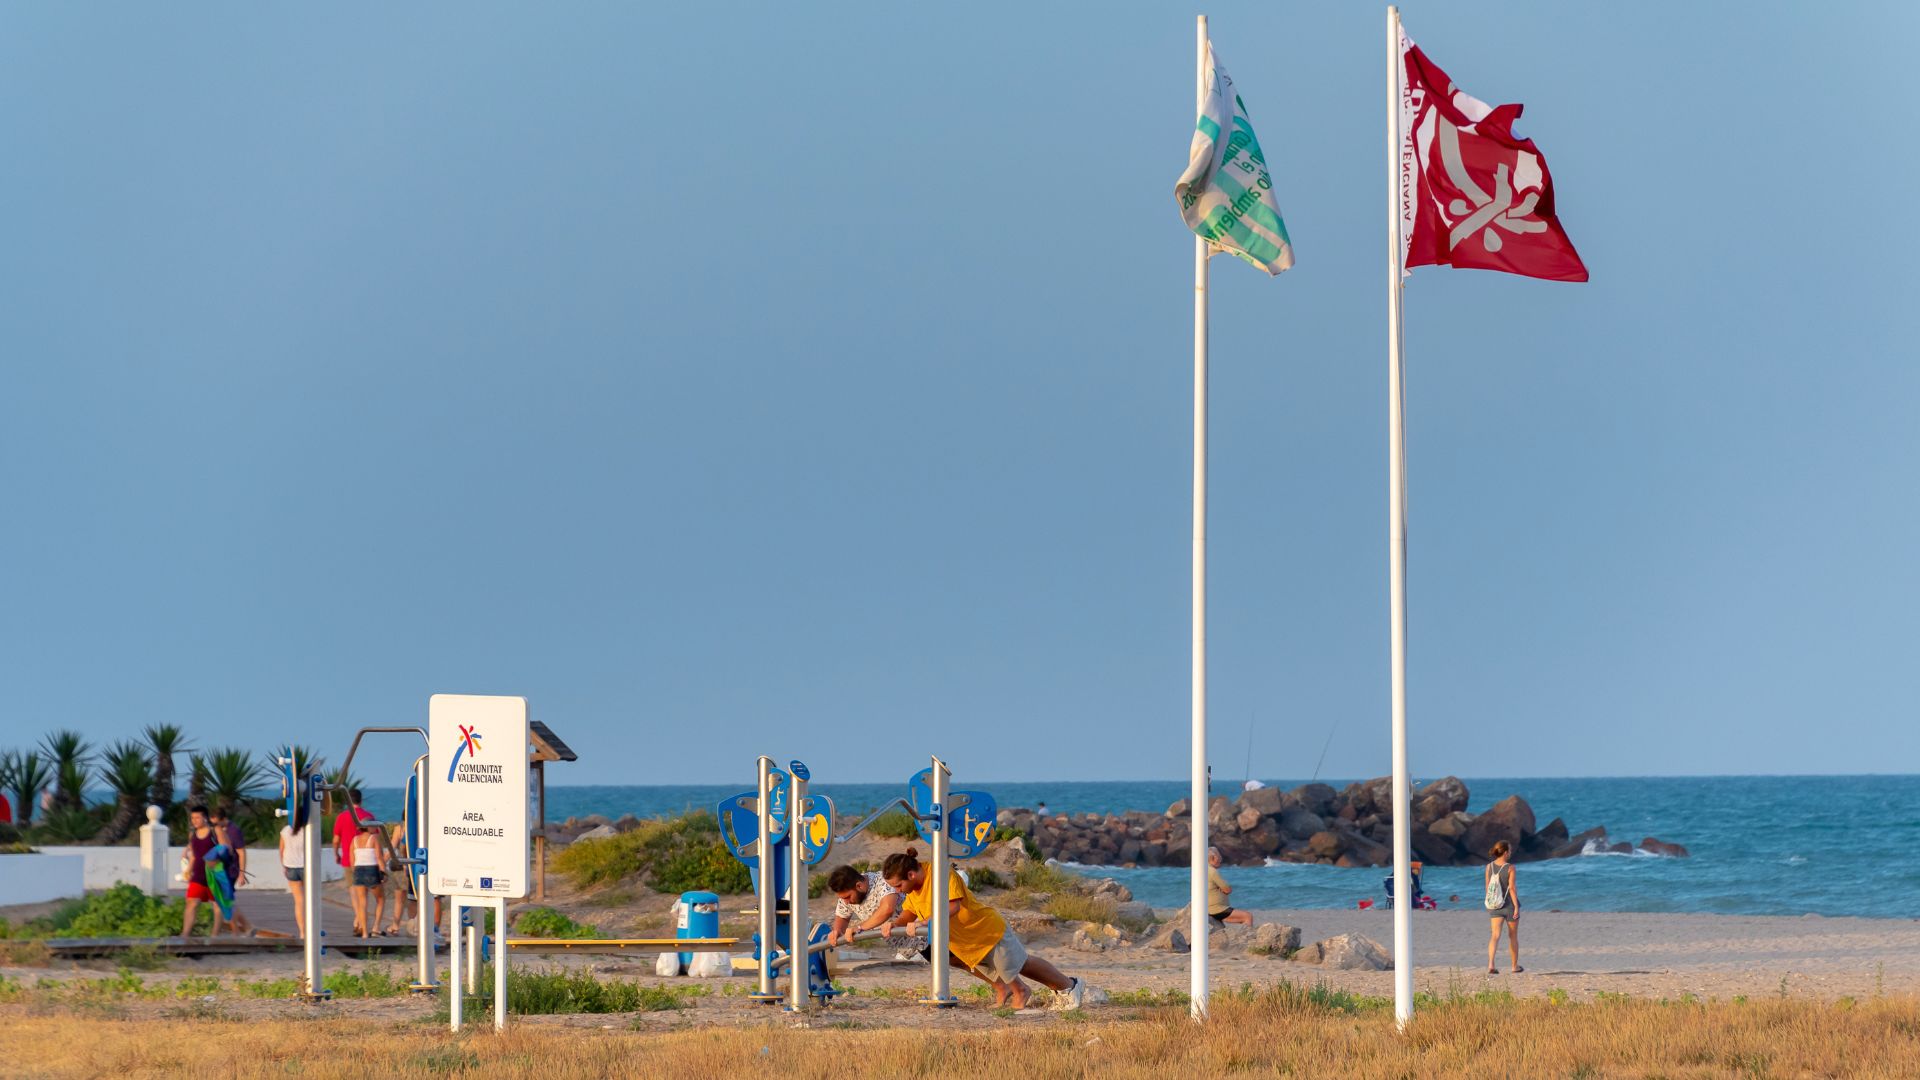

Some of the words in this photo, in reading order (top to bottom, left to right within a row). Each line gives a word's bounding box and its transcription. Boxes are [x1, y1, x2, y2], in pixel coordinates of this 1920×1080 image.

[459, 763, 503, 774] COMUNITAT
[457, 773, 503, 784] VALENCIANA
[443, 826, 504, 837] BIOSALUDABLE
